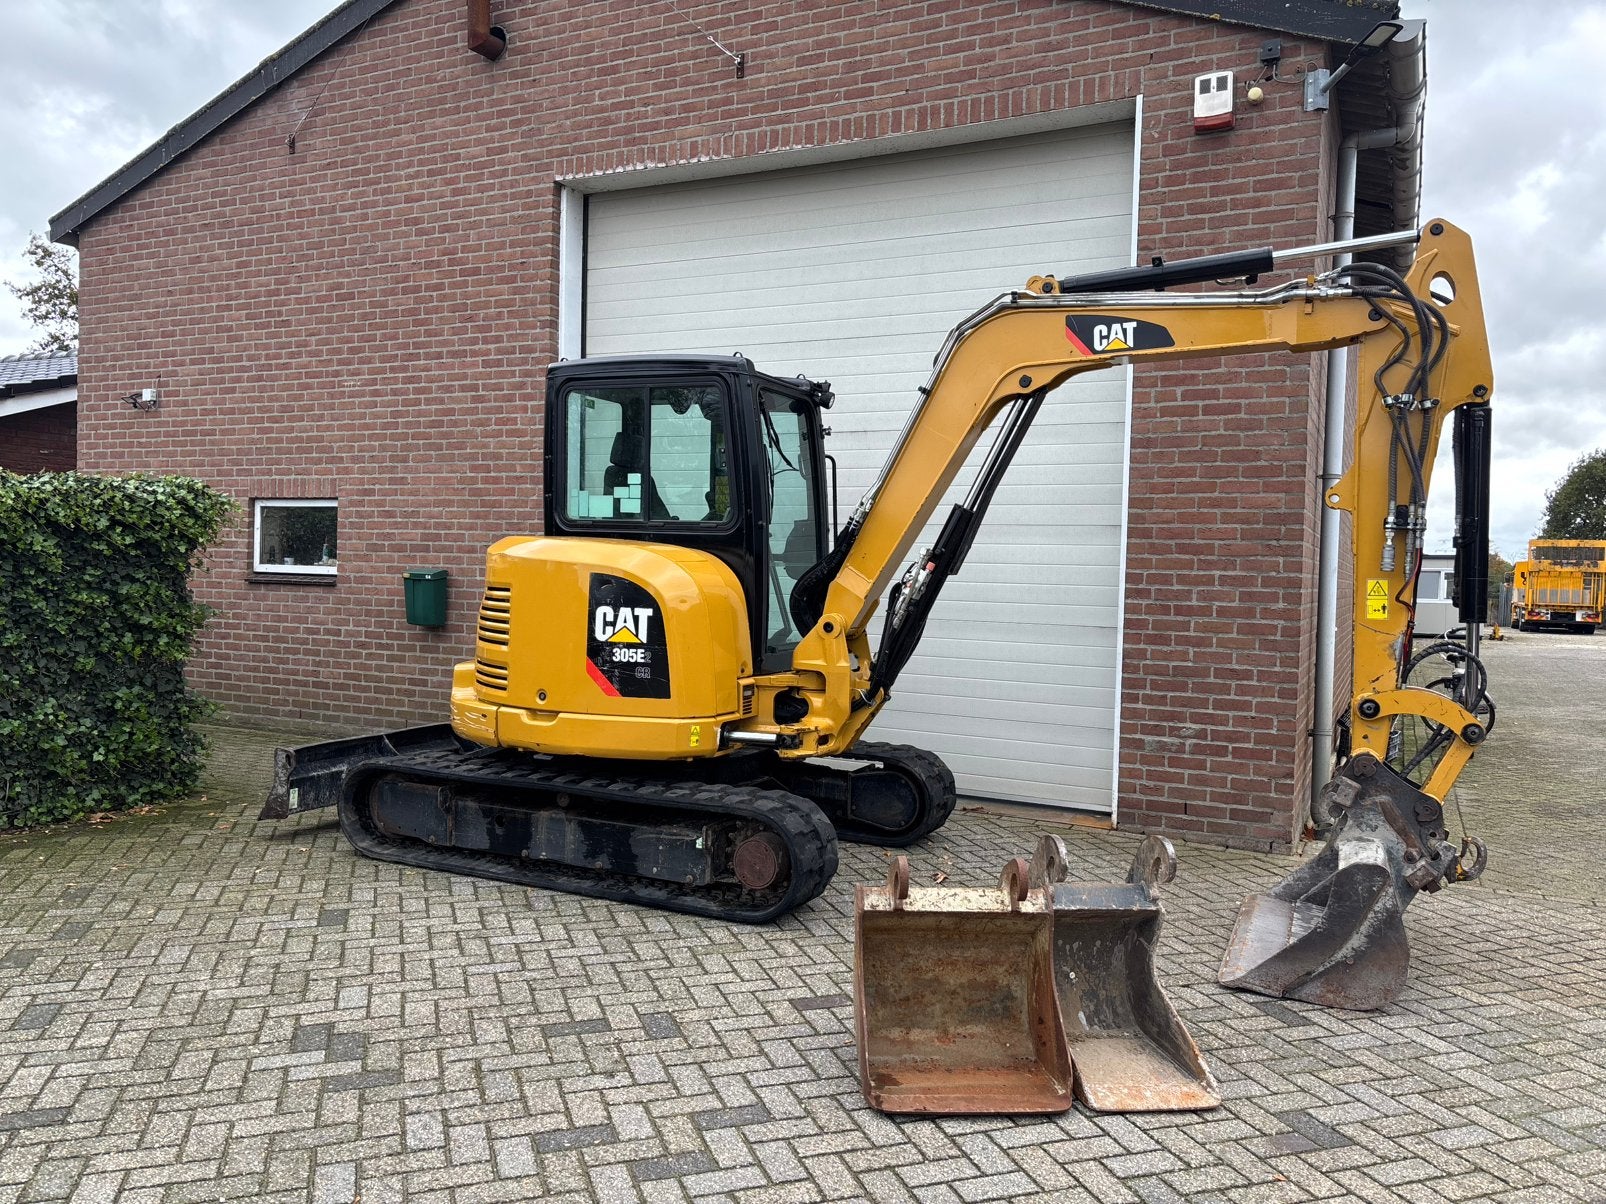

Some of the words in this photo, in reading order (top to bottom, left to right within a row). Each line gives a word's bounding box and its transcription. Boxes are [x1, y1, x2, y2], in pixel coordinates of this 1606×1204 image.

[1093, 321, 1137, 351] CAT
[594, 605, 653, 643] CAT
[612, 647, 652, 663] 305E2
[635, 666, 651, 679] CR
